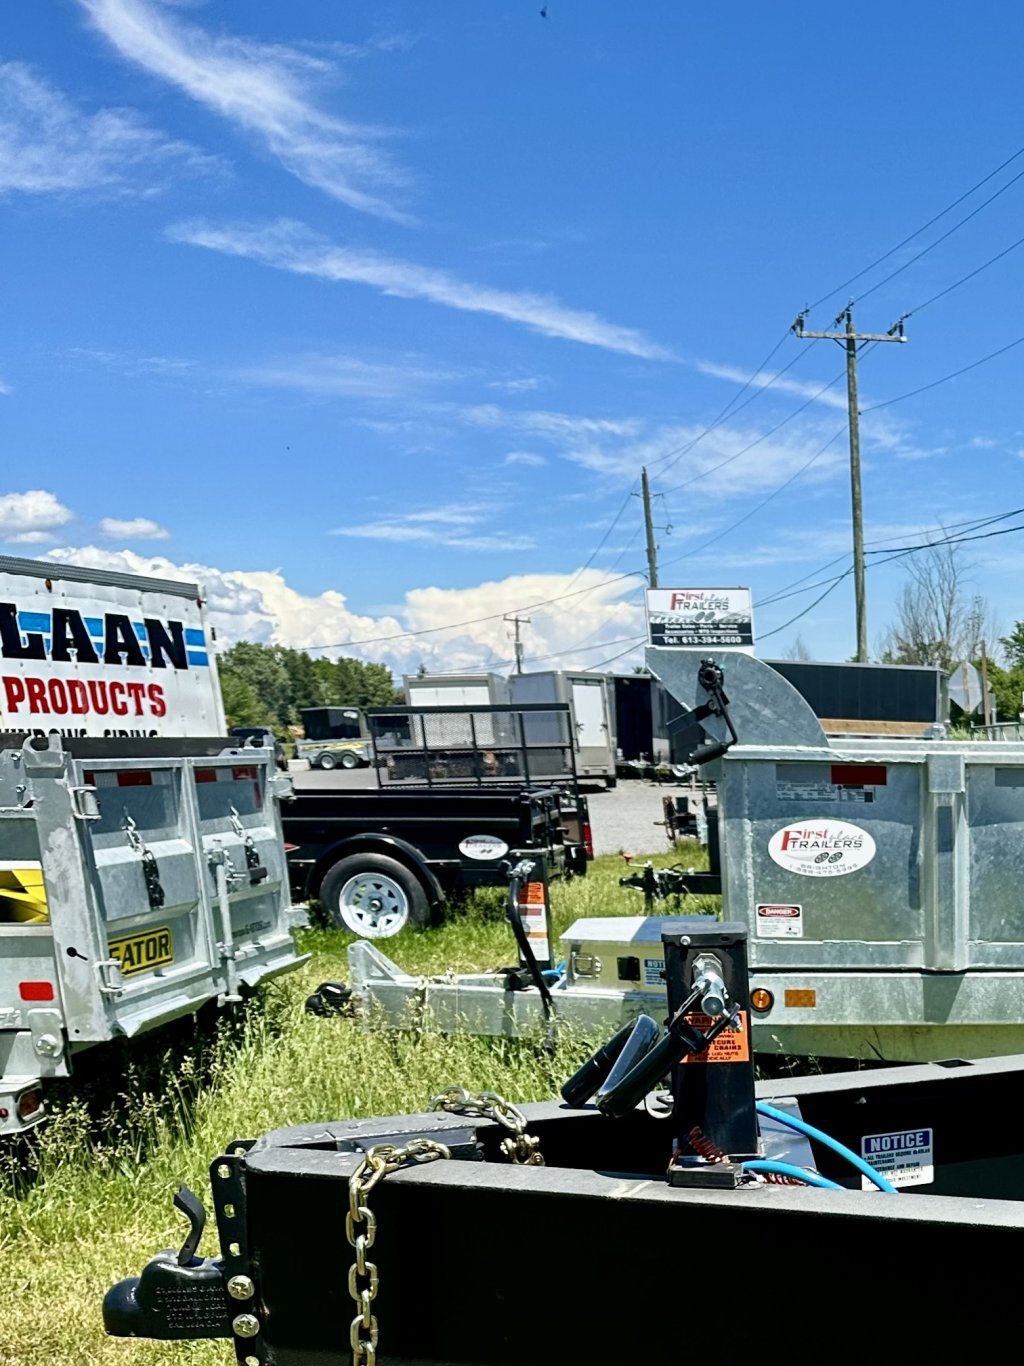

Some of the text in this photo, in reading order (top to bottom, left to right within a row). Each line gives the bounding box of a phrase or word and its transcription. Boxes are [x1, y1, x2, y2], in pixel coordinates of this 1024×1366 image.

[671, 592, 704, 610] First
[678, 601, 729, 610] TRAILERS
[0, 602, 188, 670] LAAN
[662, 636, 679, 644] Tel.
[2, 676, 166, 718] PRODUCTS
[781, 829, 828, 851] First
[790, 840, 863, 849] TRAILERS
[870, 1132, 924, 1152] NOTICE
